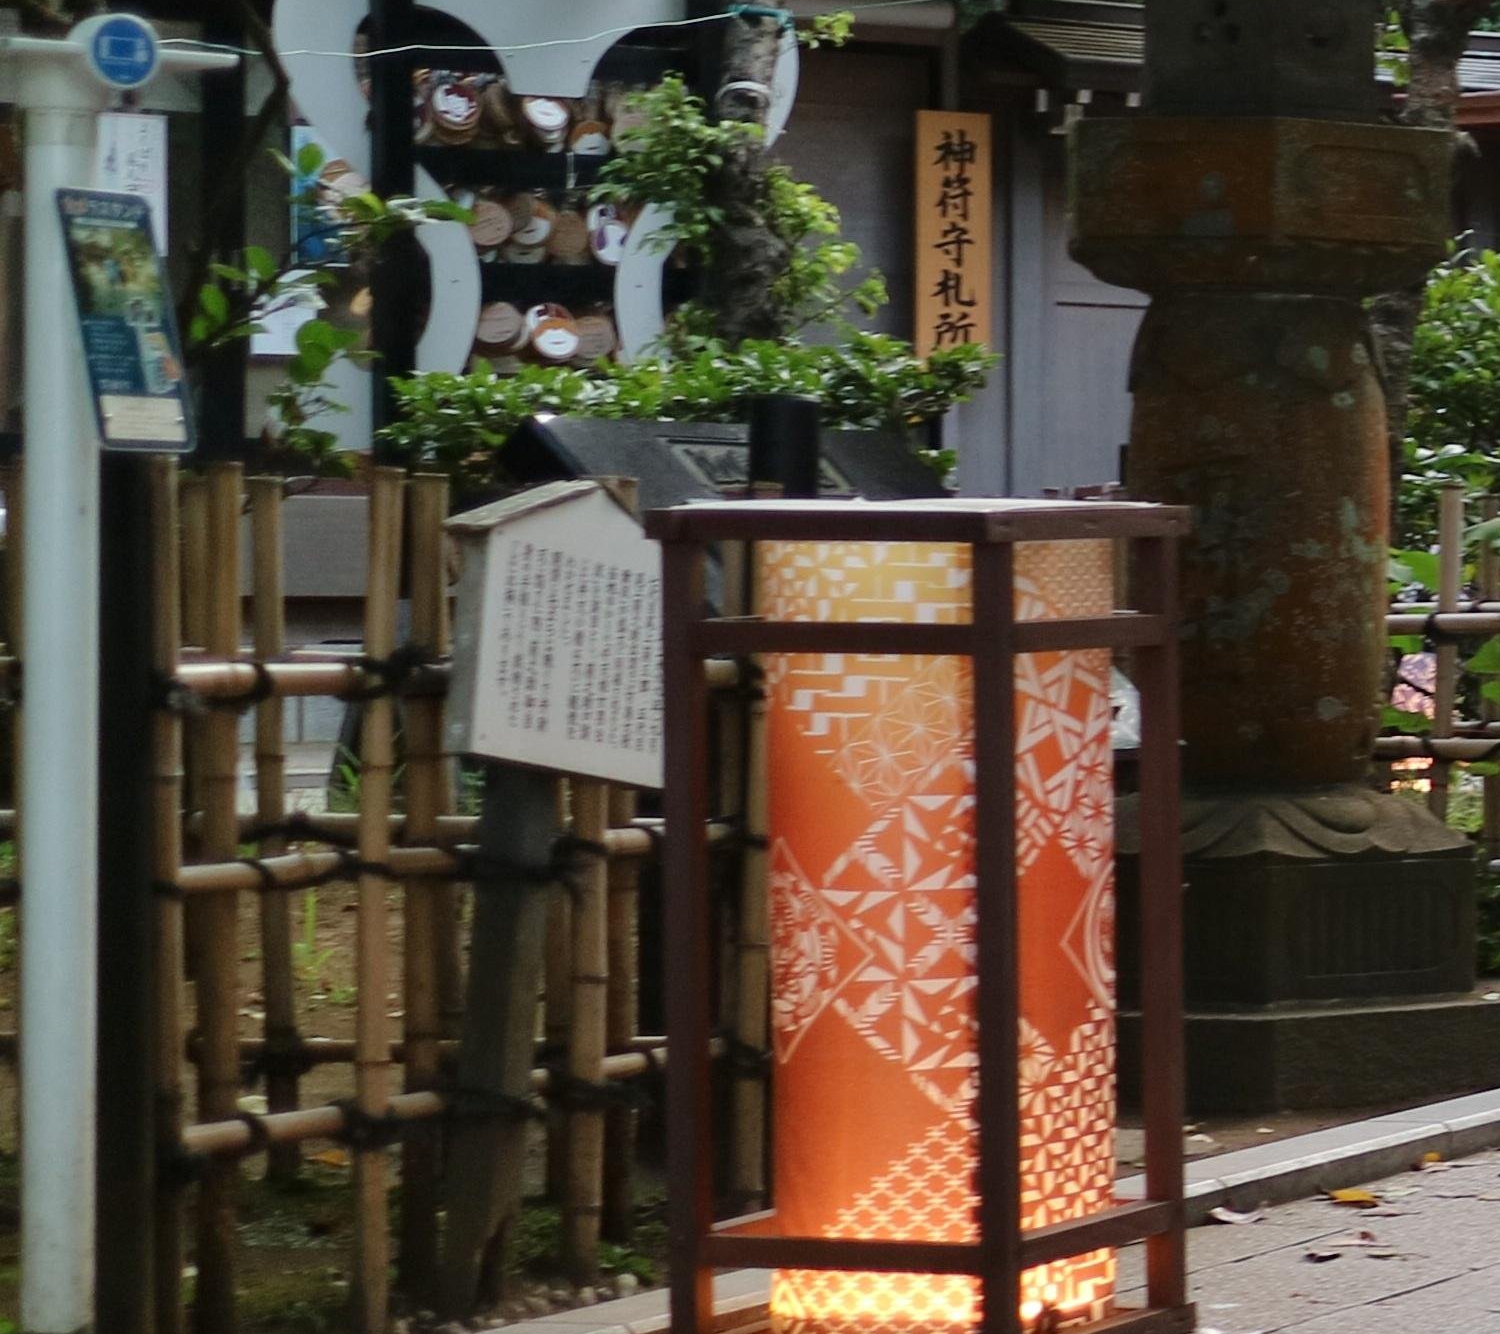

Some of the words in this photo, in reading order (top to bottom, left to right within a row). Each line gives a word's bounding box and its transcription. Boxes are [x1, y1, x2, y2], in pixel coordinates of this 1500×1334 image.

[930, 128, 978, 352] 神符守札所
